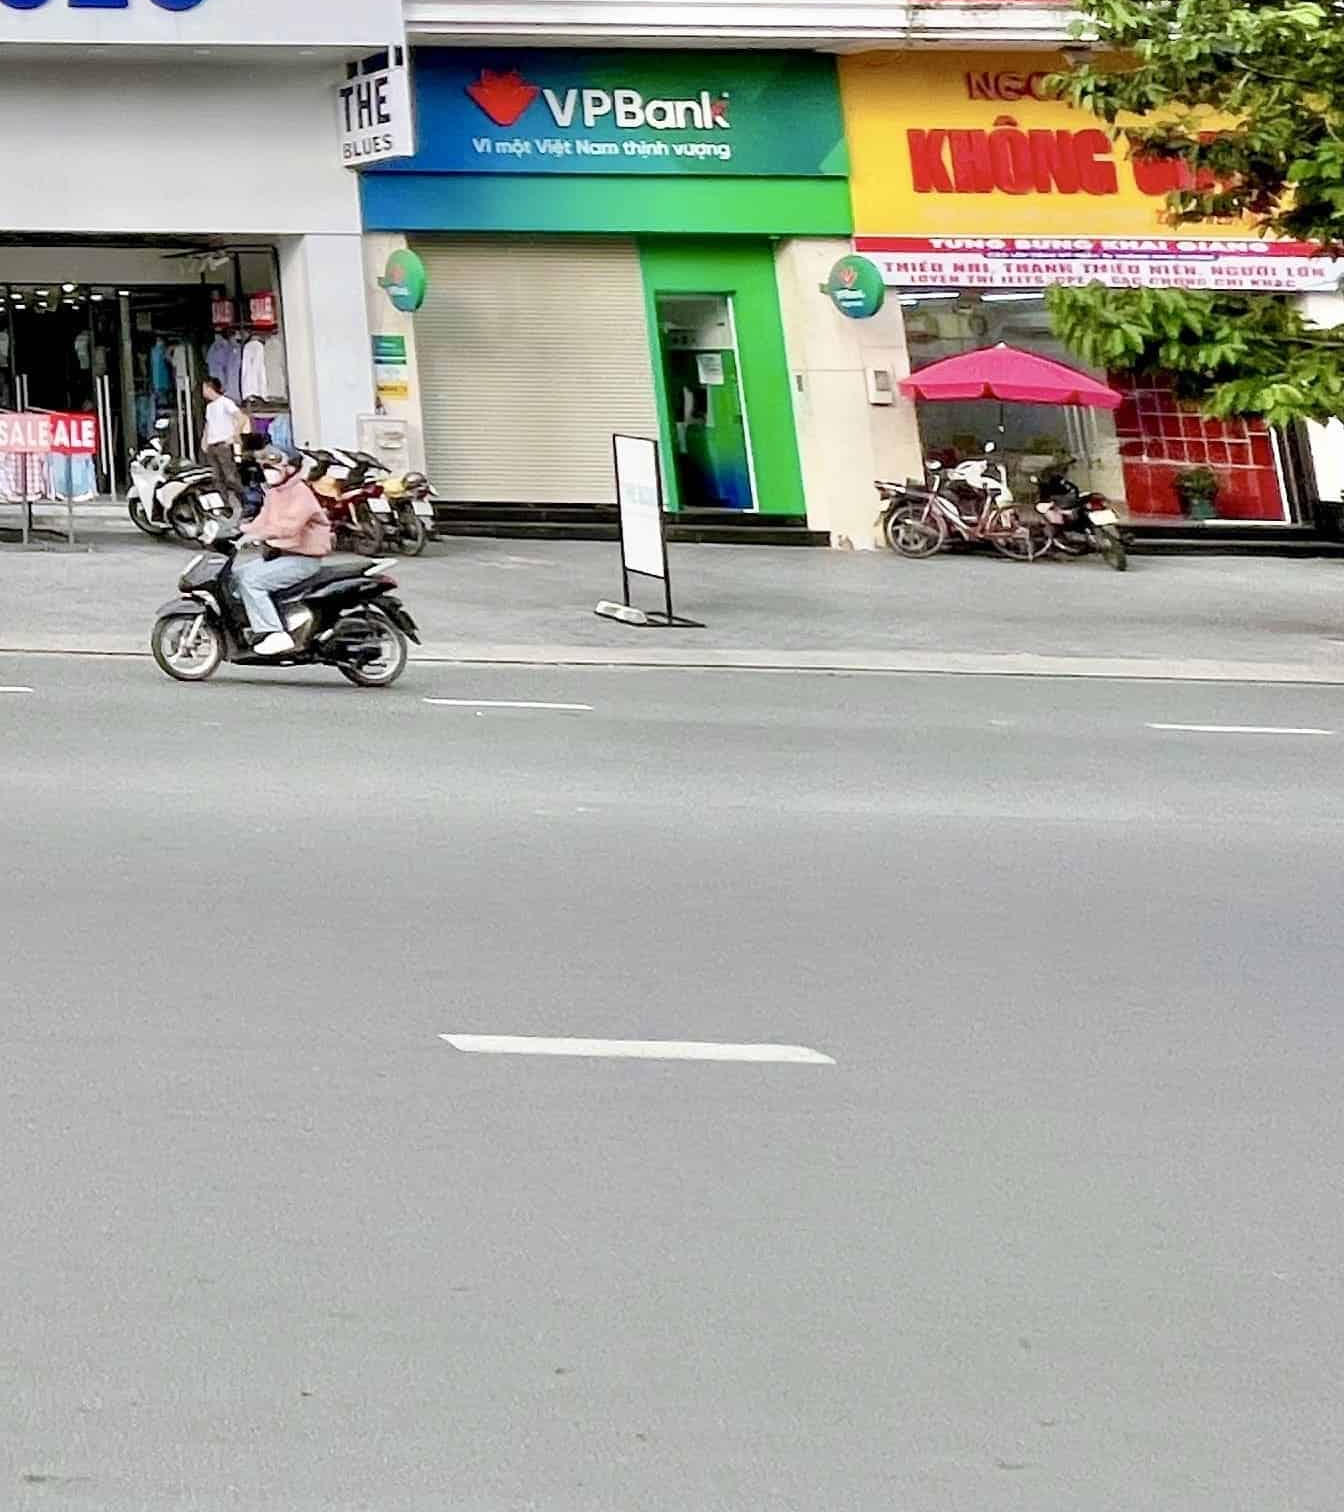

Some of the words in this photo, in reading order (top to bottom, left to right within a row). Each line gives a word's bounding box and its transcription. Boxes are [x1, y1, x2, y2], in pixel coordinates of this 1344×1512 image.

[339, 76, 391, 132] THE
[541, 88, 731, 130] VPBank
[343, 133, 392, 160] BLUES
[575, 140, 620, 155] Nam
[906, 114, 1119, 195] KHÔNG
